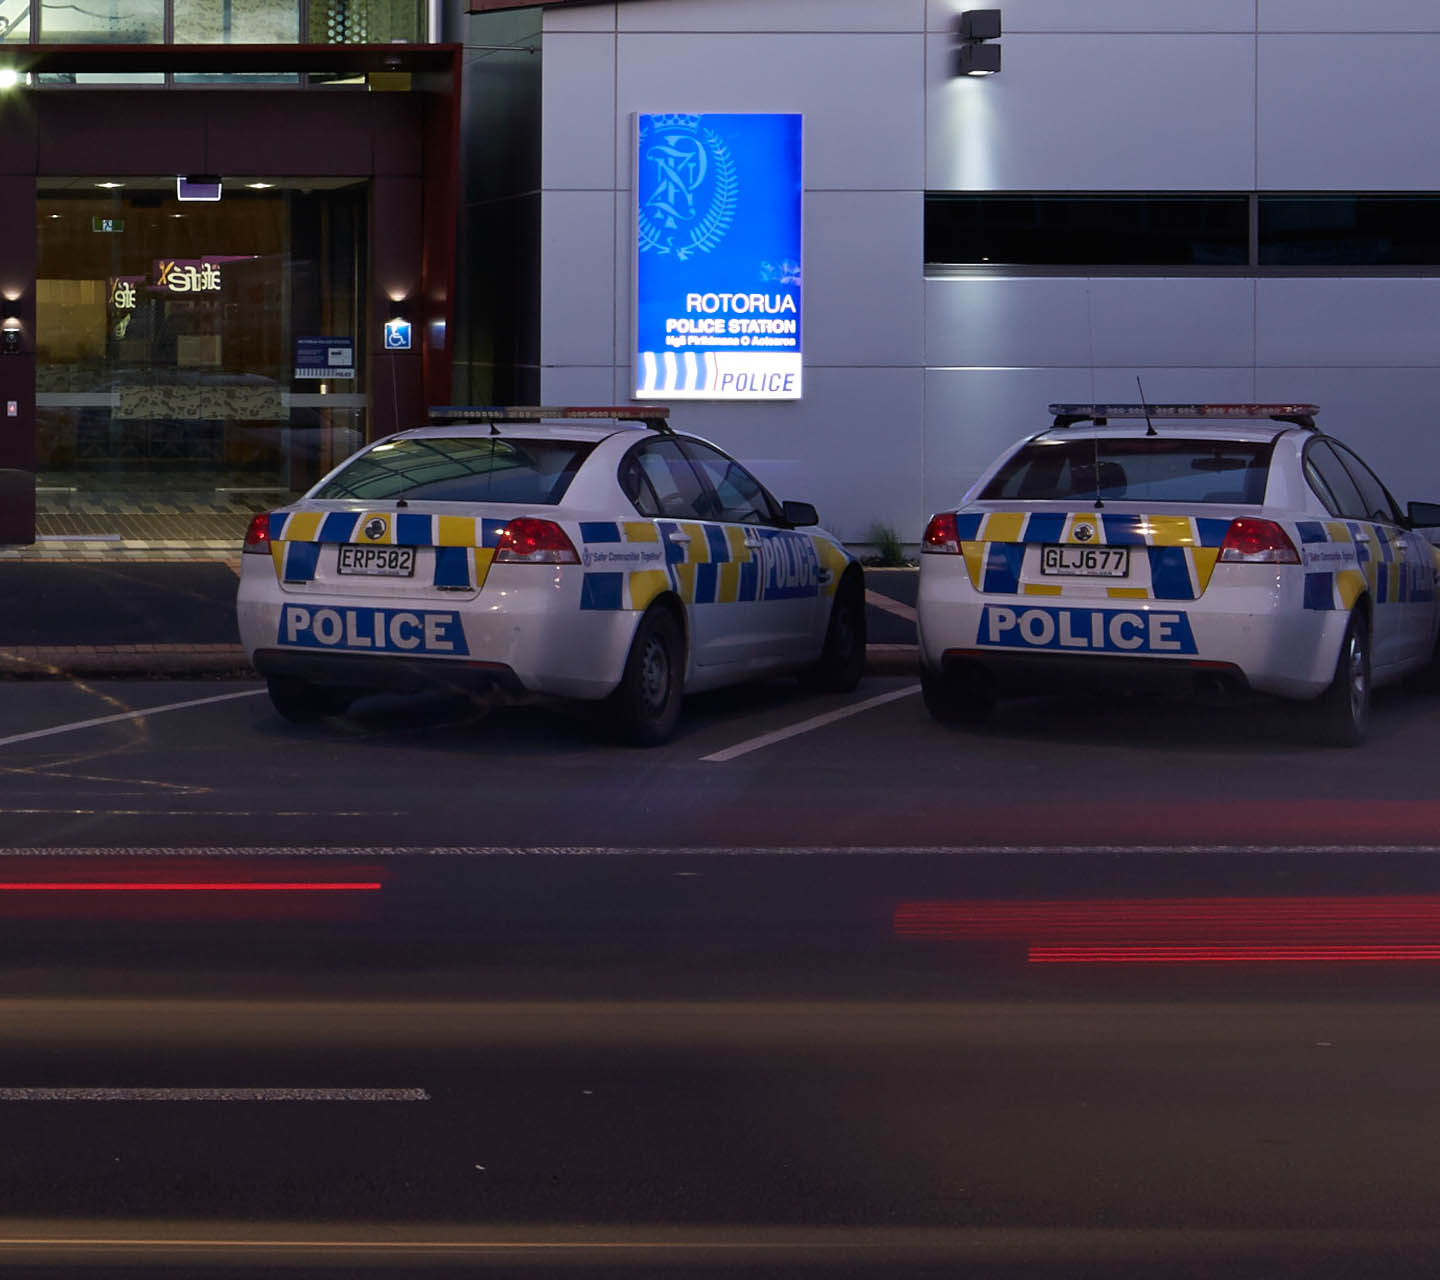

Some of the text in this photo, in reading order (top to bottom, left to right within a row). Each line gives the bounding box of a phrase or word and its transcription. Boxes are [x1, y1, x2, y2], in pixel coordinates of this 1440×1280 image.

[686, 293, 796, 313] ROTORUA
[666, 318, 796, 333] POLICE STATION
[740, 336, 750, 346] O
[721, 372, 795, 392] POLICE
[342, 549, 411, 570] ERP502
[1046, 549, 1124, 570] GLJ677
[286, 606, 454, 650] POLICE
[988, 607, 1181, 650] POLICE
